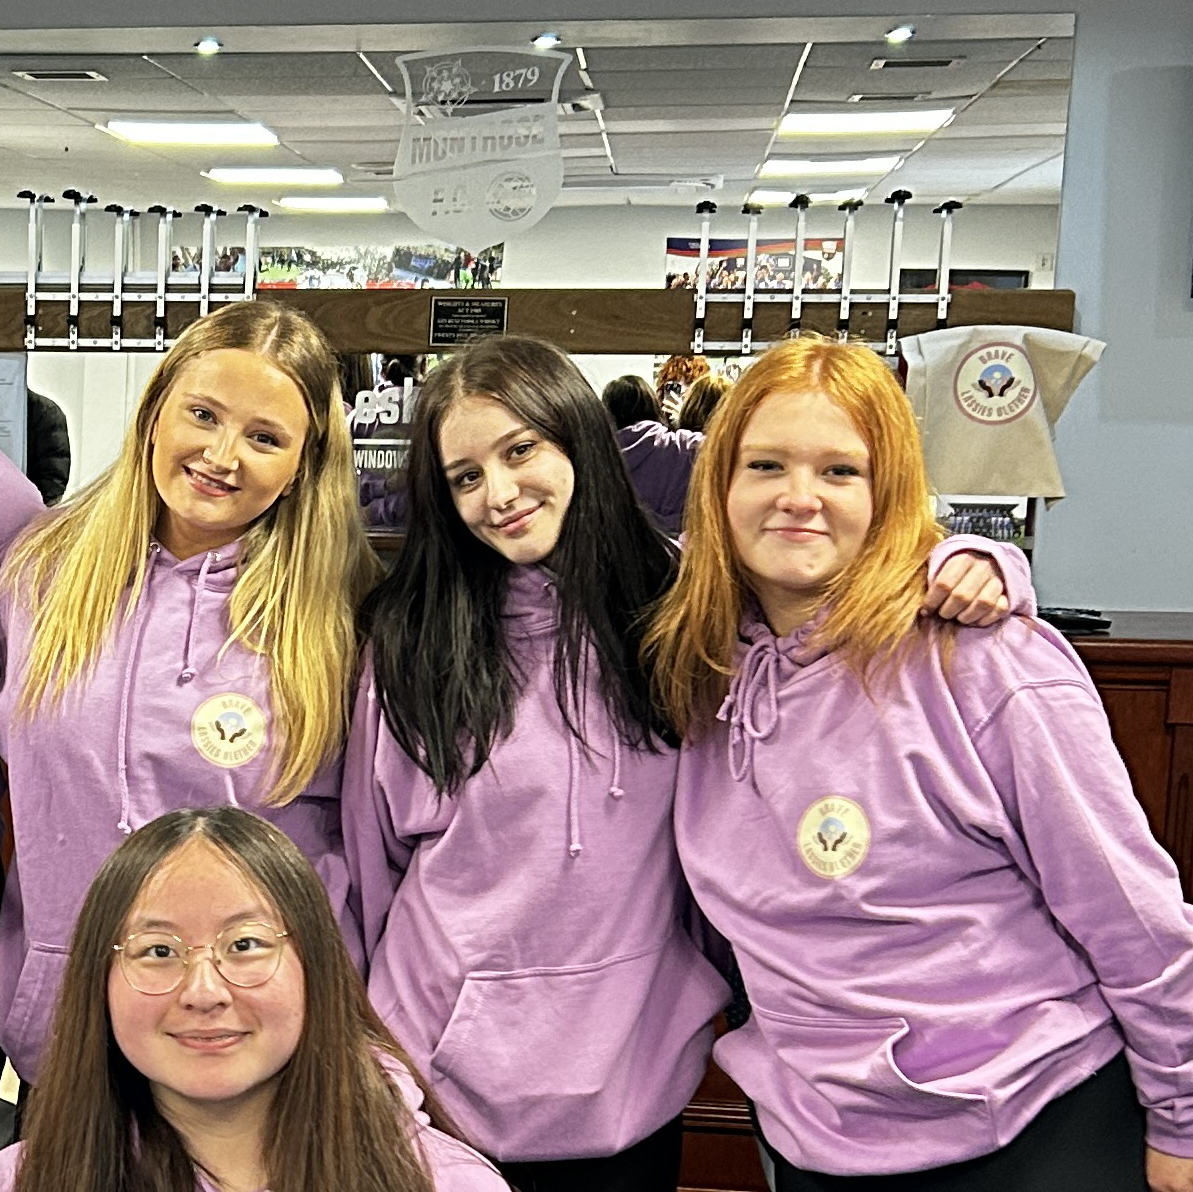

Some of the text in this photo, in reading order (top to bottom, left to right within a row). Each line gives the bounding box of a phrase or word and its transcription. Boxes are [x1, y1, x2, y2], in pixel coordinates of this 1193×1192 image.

[492, 66, 541, 93] 1879
[978, 350, 1015, 365] BRAVE
[961, 389, 994, 418] LASSIES
